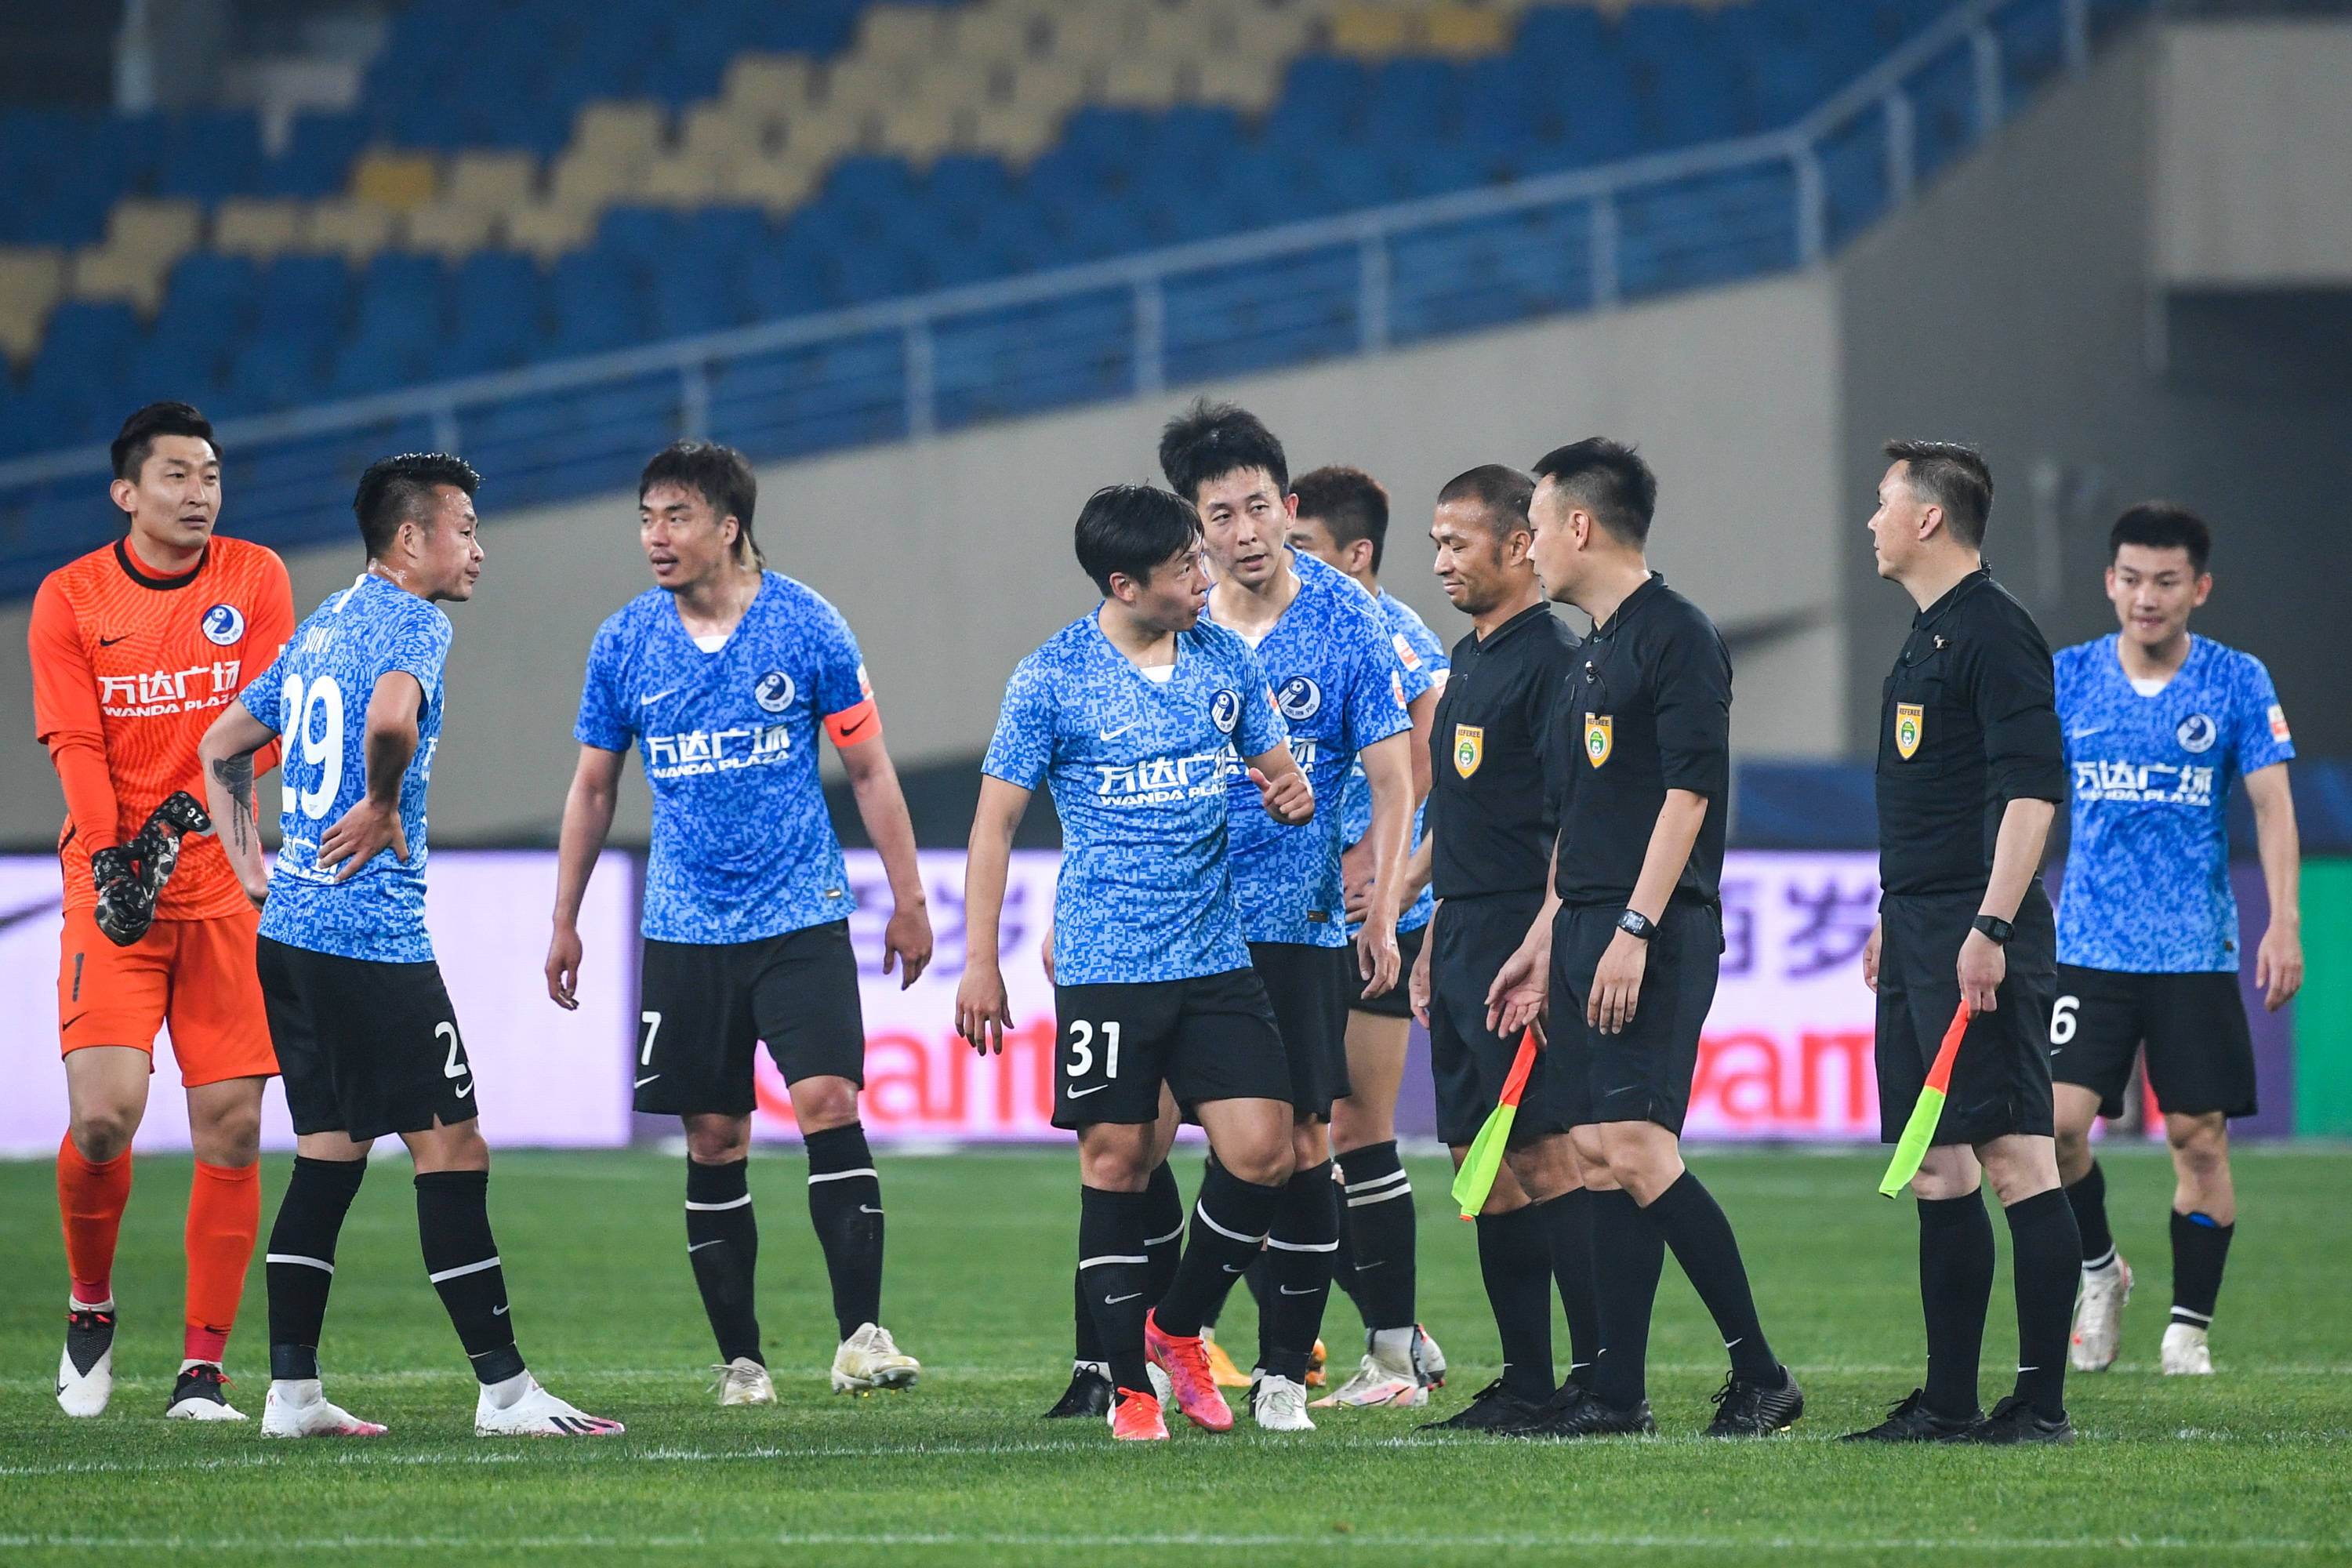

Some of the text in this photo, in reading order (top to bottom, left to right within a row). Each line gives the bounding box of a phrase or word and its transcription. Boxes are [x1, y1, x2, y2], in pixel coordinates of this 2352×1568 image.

[98, 660, 241, 704] 万达广场
[103, 702, 181, 717] WANDA
[281, 673, 344, 820] 29
[646, 725, 791, 766] 万达广场
[718, 750, 789, 771] PLAZA
[1100, 781, 1227, 806] WANDA PLAZ
[2071, 759, 2214, 795] 万达广场
[641, 1011, 662, 1065] 7
[1067, 1019, 1120, 1079] 31
